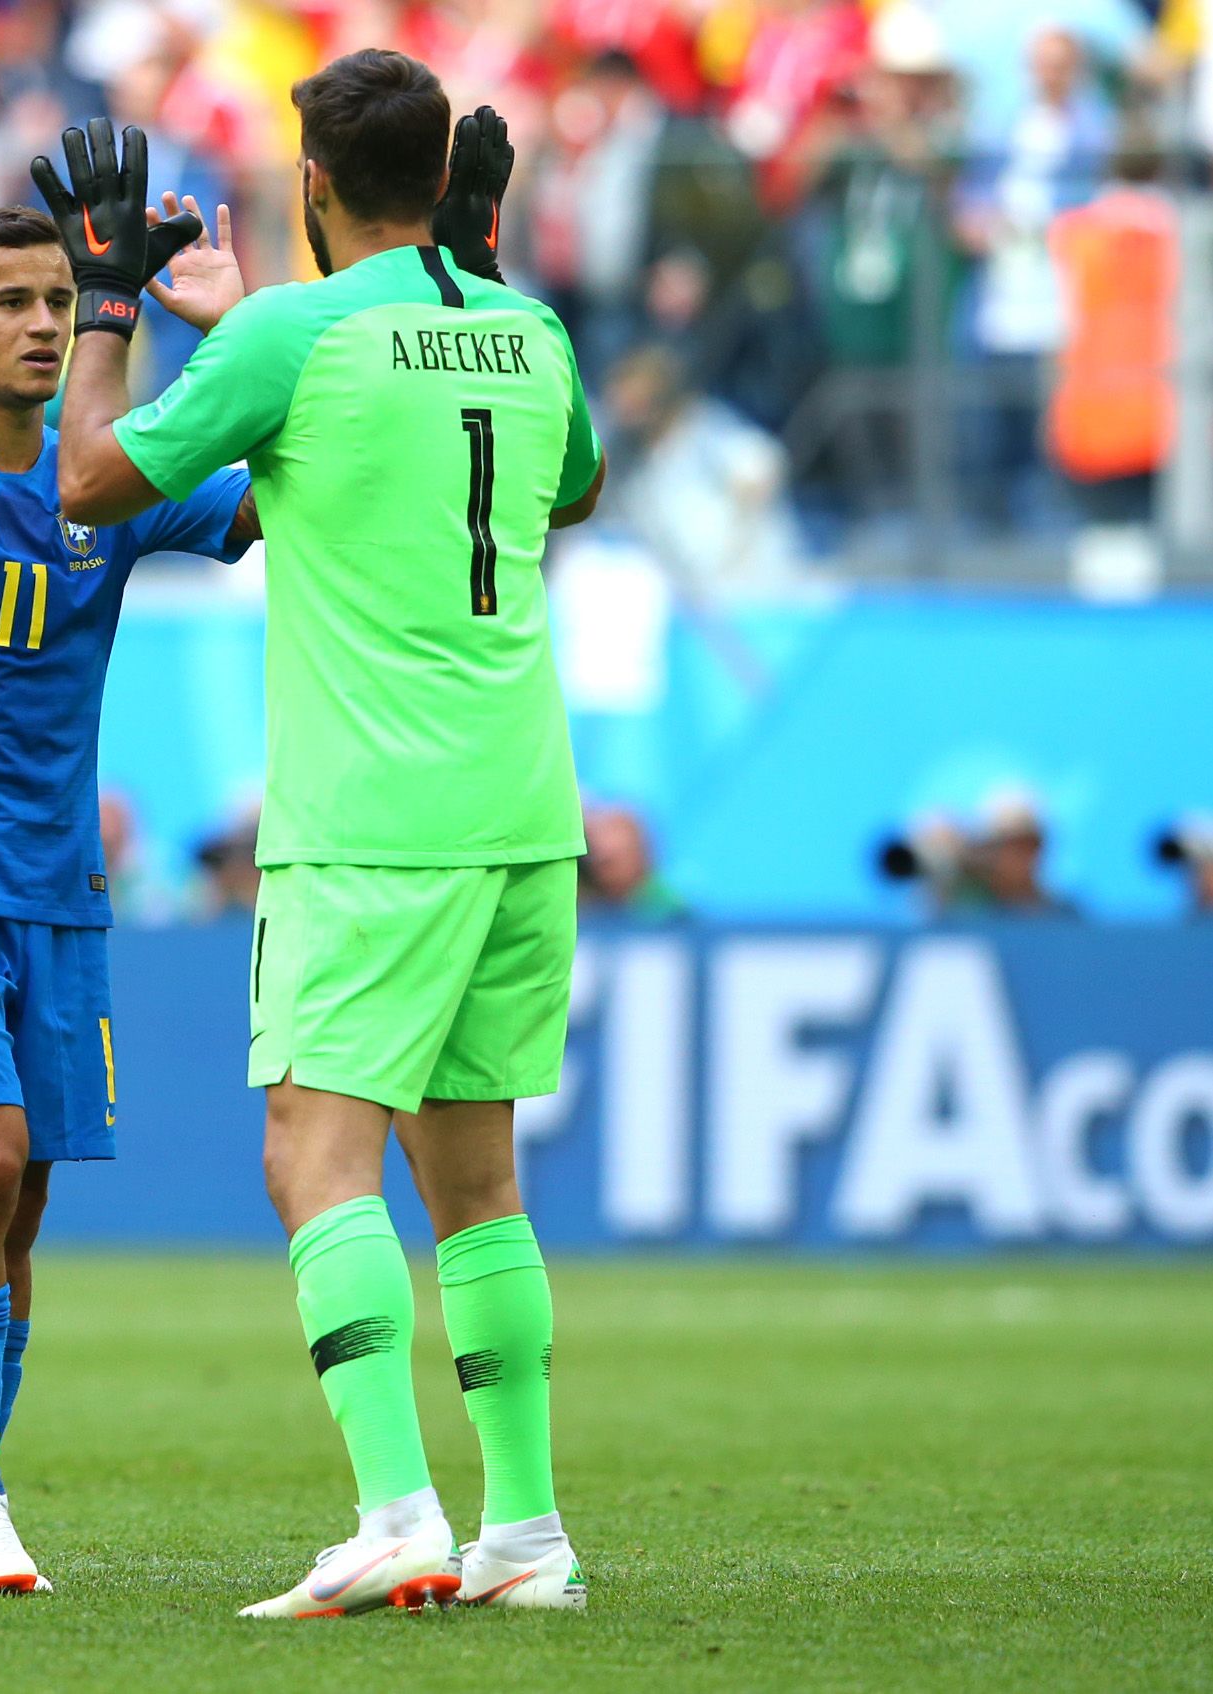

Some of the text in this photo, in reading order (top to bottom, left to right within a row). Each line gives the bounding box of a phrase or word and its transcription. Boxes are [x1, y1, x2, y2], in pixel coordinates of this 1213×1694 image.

[98, 299, 136, 320] AB1
[392, 330, 531, 374] A.BECKER
[460, 408, 497, 616] 1
[69, 556, 107, 572] BRASIL
